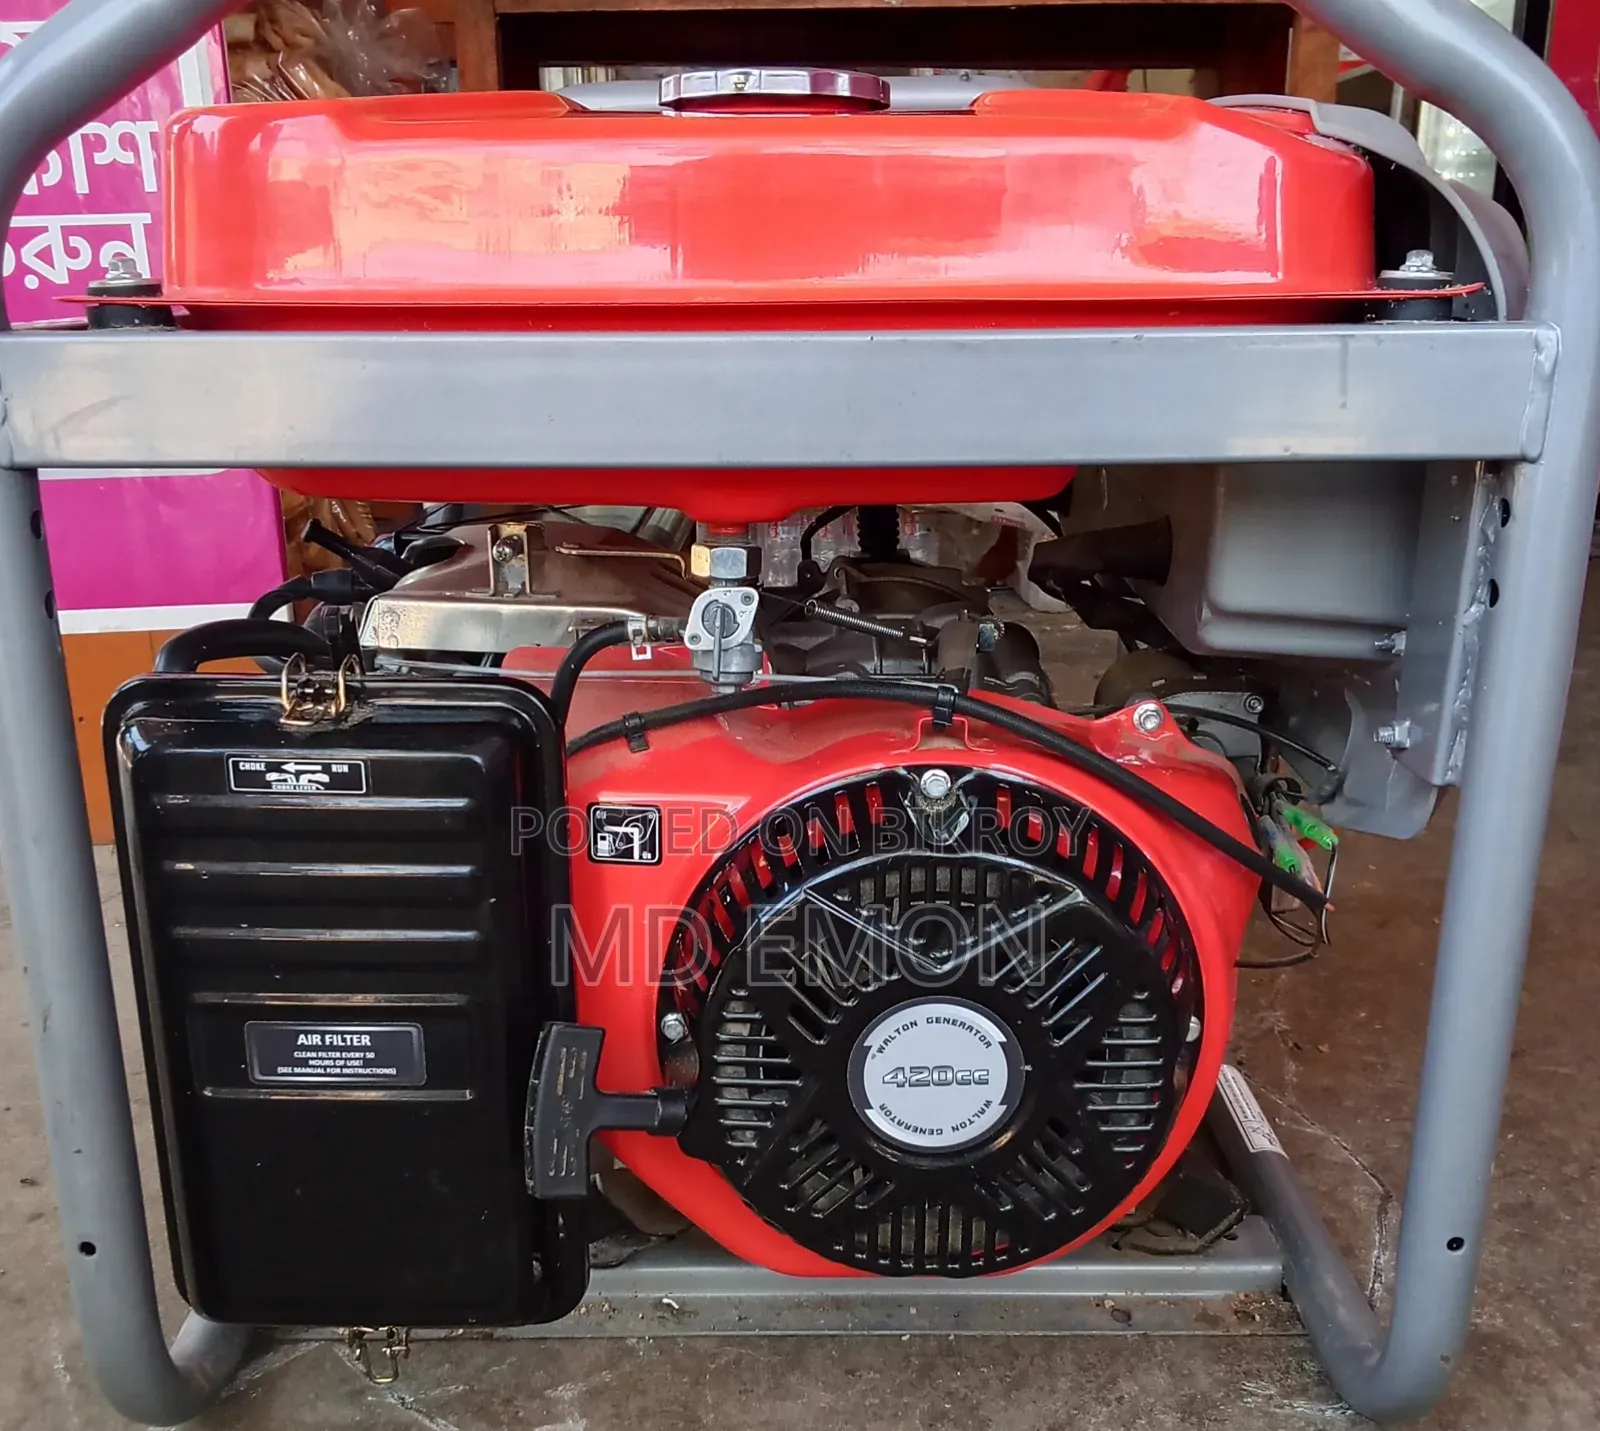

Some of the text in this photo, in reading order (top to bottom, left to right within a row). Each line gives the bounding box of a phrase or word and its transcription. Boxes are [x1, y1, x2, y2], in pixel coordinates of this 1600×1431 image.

[239, 762, 266, 771] CHOKE
[331, 764, 349, 773] RUN
[297, 1034, 371, 1046] AIR FILTER
[876, 1016, 992, 1055] WALTON GENERATOR
[342, 1067, 396, 1075] INSTRUCTIONS)
[879, 1099, 993, 1136] WALTON GENERATOR
